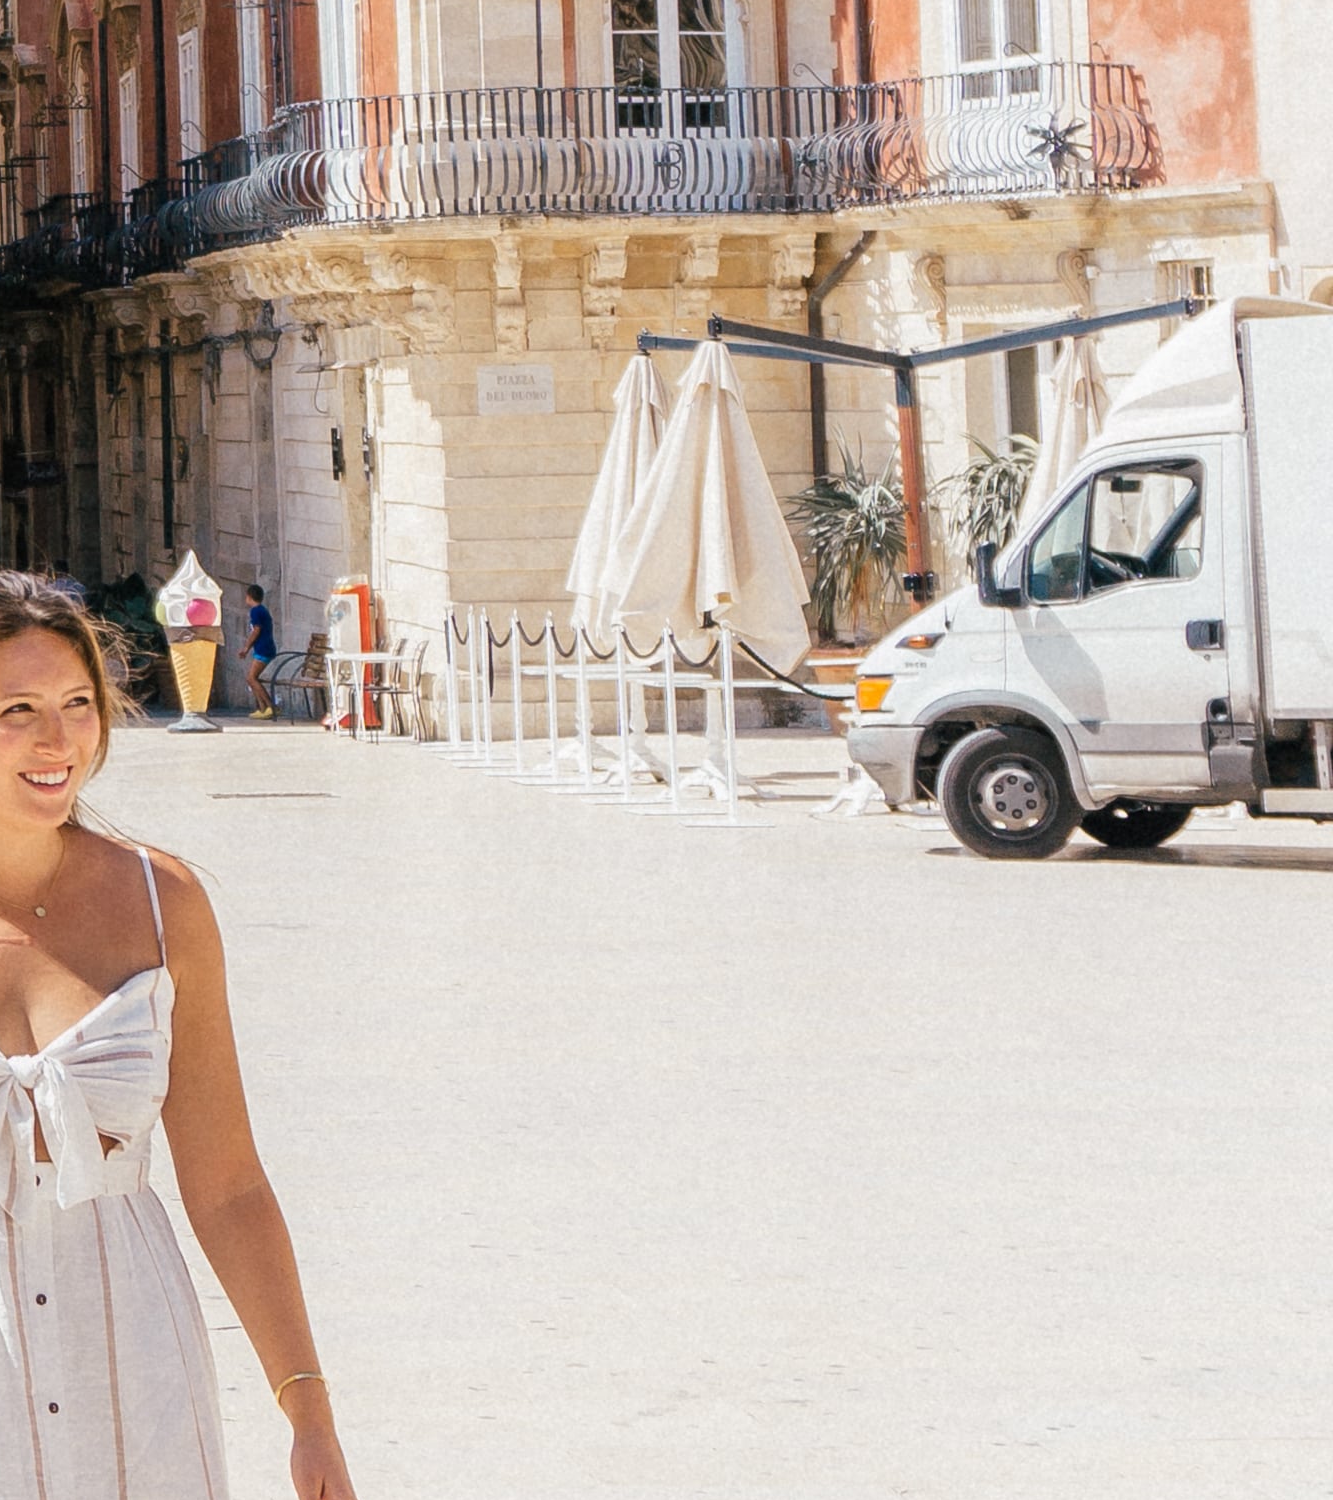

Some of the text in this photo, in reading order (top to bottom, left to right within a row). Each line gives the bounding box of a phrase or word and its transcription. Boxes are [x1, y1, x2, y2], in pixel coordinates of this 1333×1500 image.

[496, 375, 536, 385] PIAZZA
[486, 390, 548, 401] DEL DUOMO
